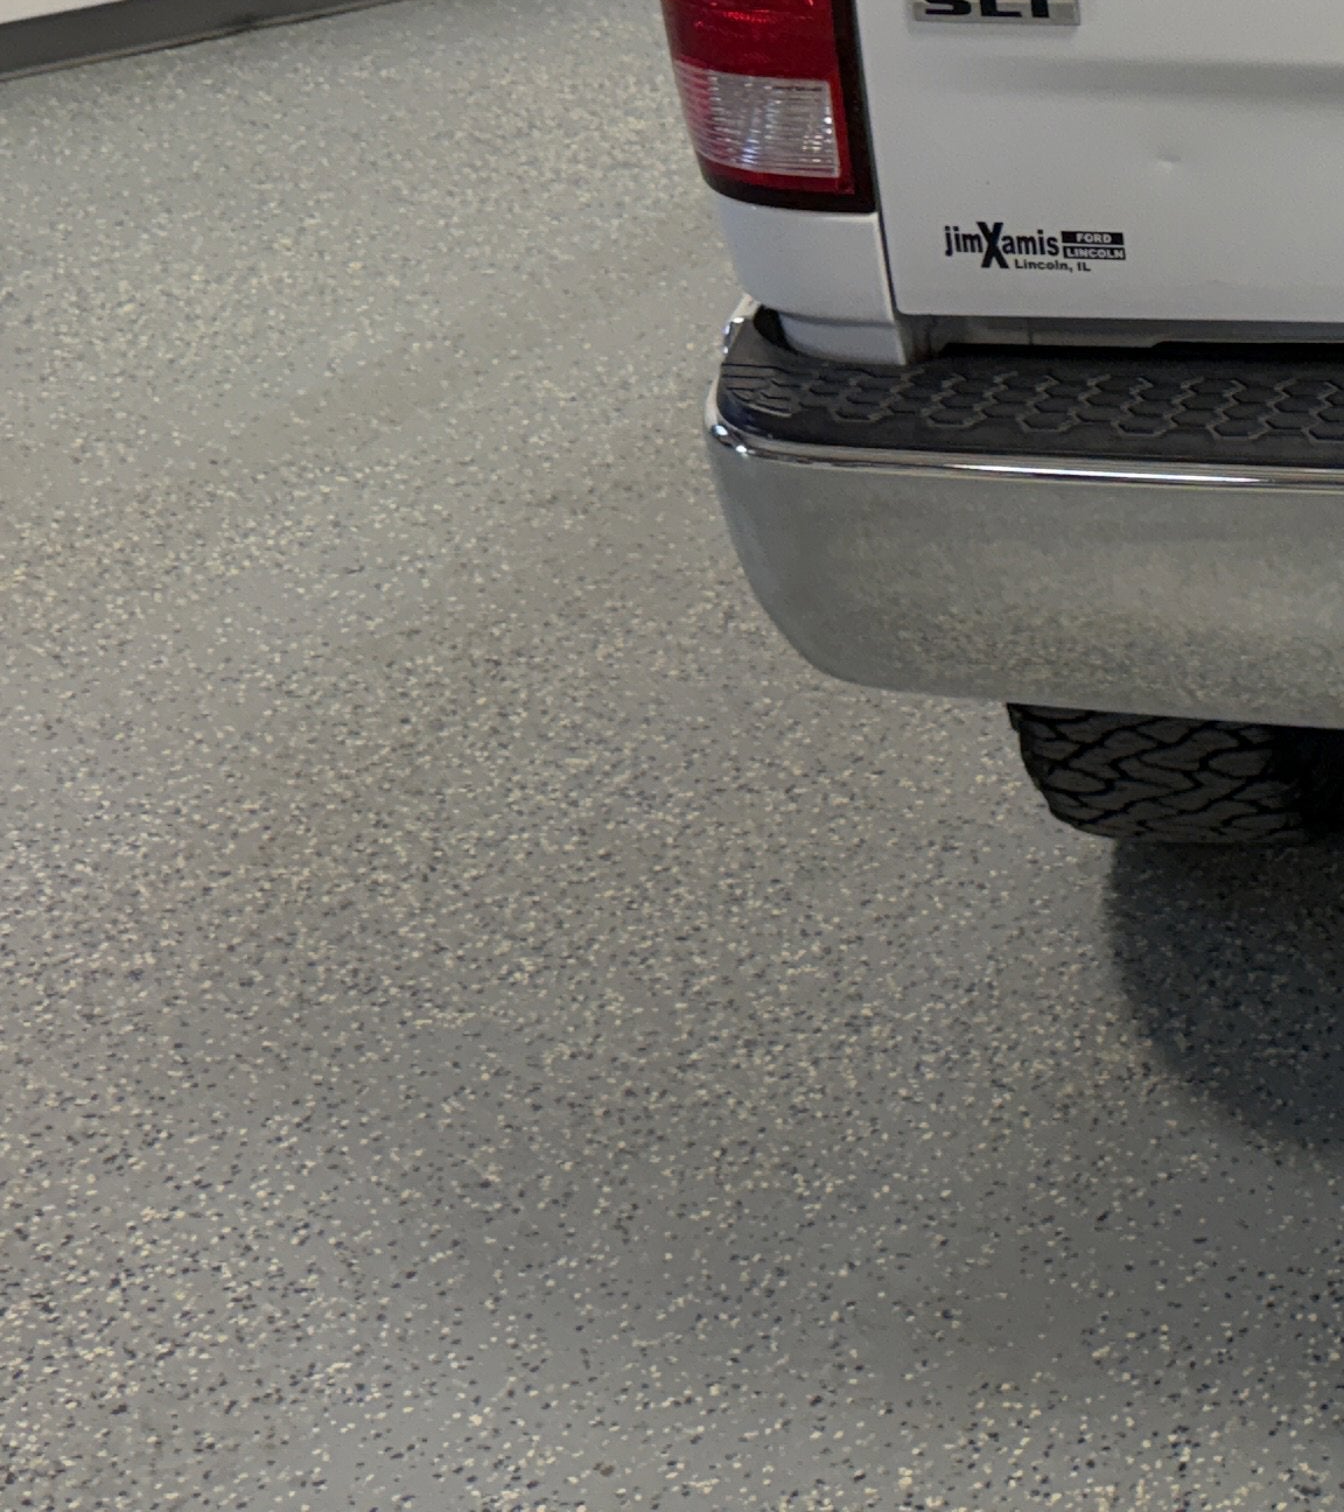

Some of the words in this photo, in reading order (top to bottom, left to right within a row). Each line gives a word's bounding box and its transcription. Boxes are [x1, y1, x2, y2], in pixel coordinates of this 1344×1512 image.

[1075, 232, 1113, 244] FORD
[1066, 247, 1125, 259] LINCOLN
[1014, 258, 1074, 273] Lincoln,
[1077, 261, 1092, 272] IL
